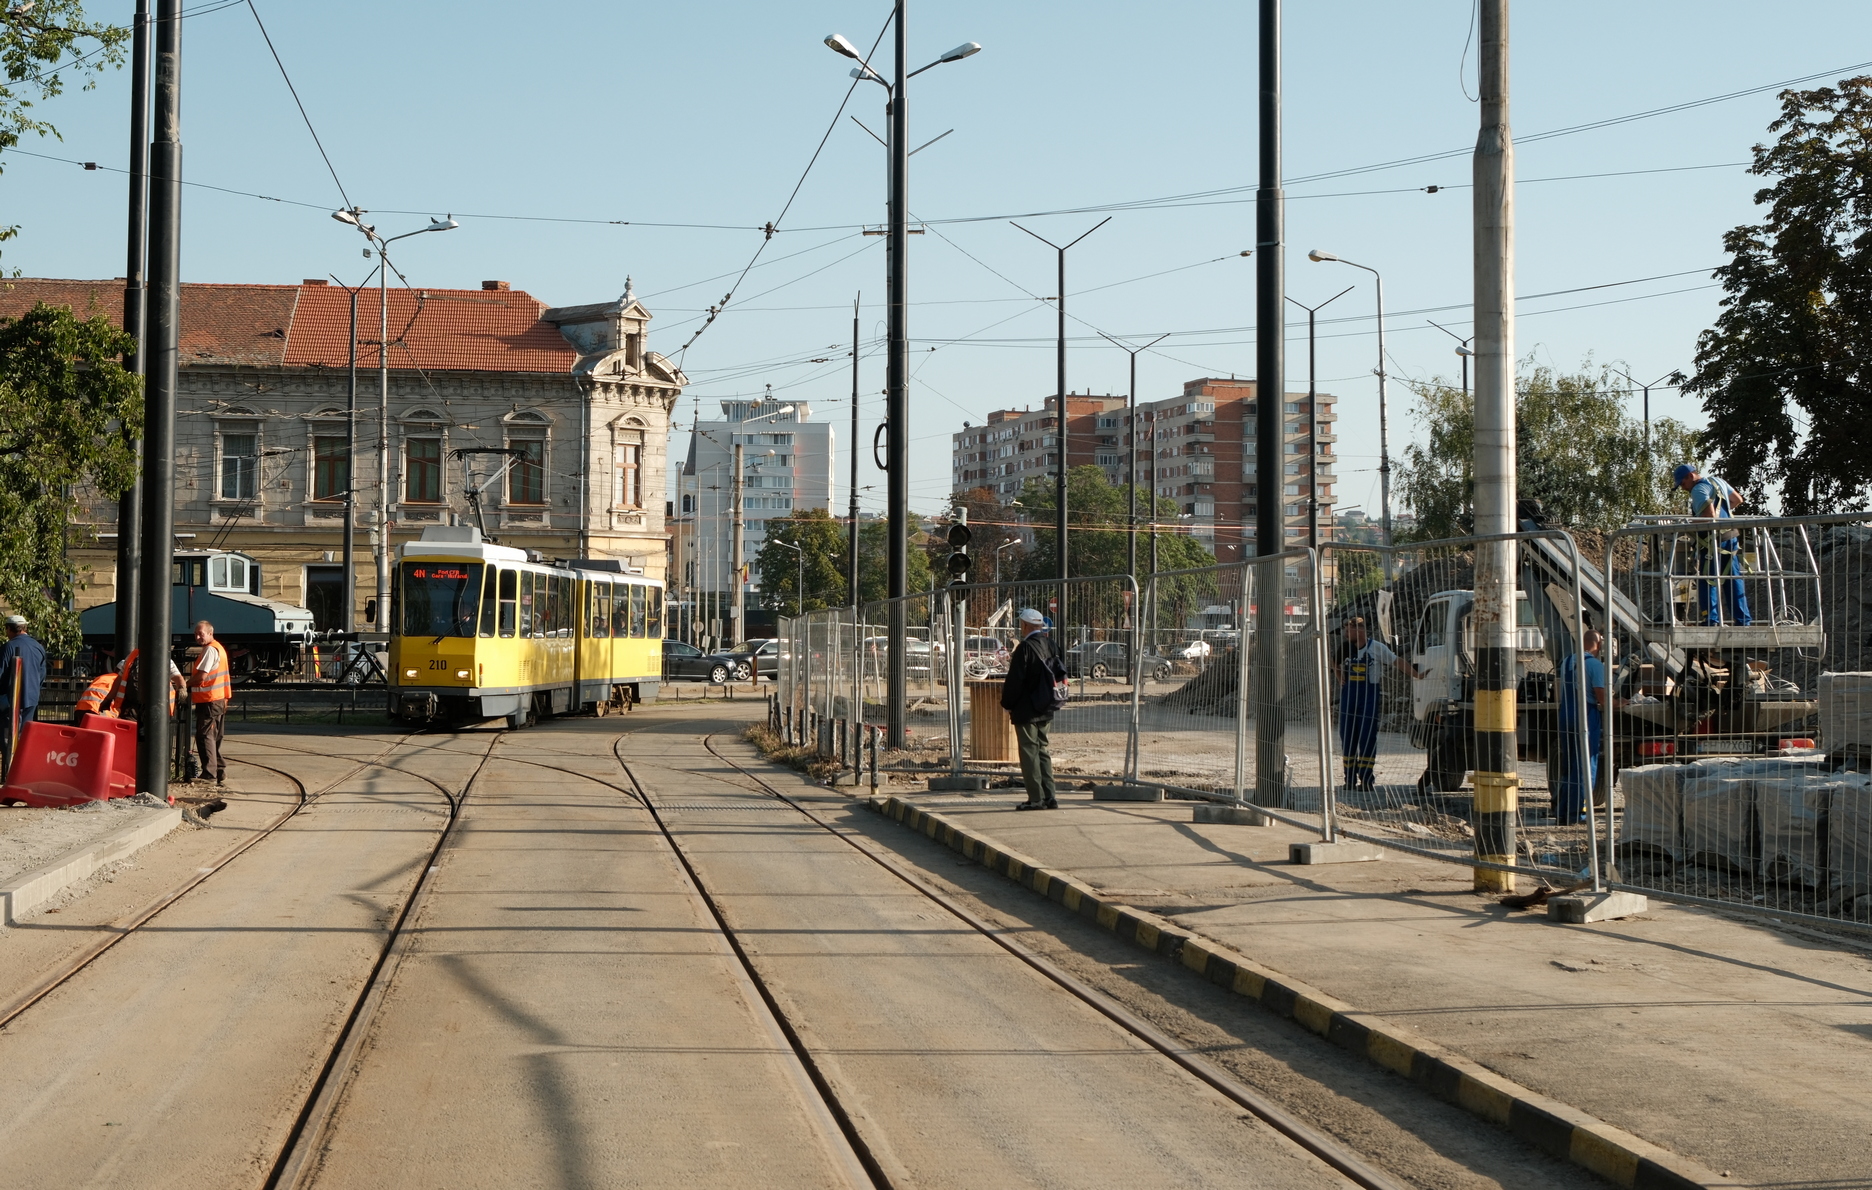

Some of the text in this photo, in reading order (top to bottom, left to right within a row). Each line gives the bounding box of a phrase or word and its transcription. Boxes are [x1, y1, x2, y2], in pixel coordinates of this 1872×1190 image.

[413, 569, 427, 578] 4N
[429, 659, 447, 670] 210
[46, 750, 79, 767] PCG
